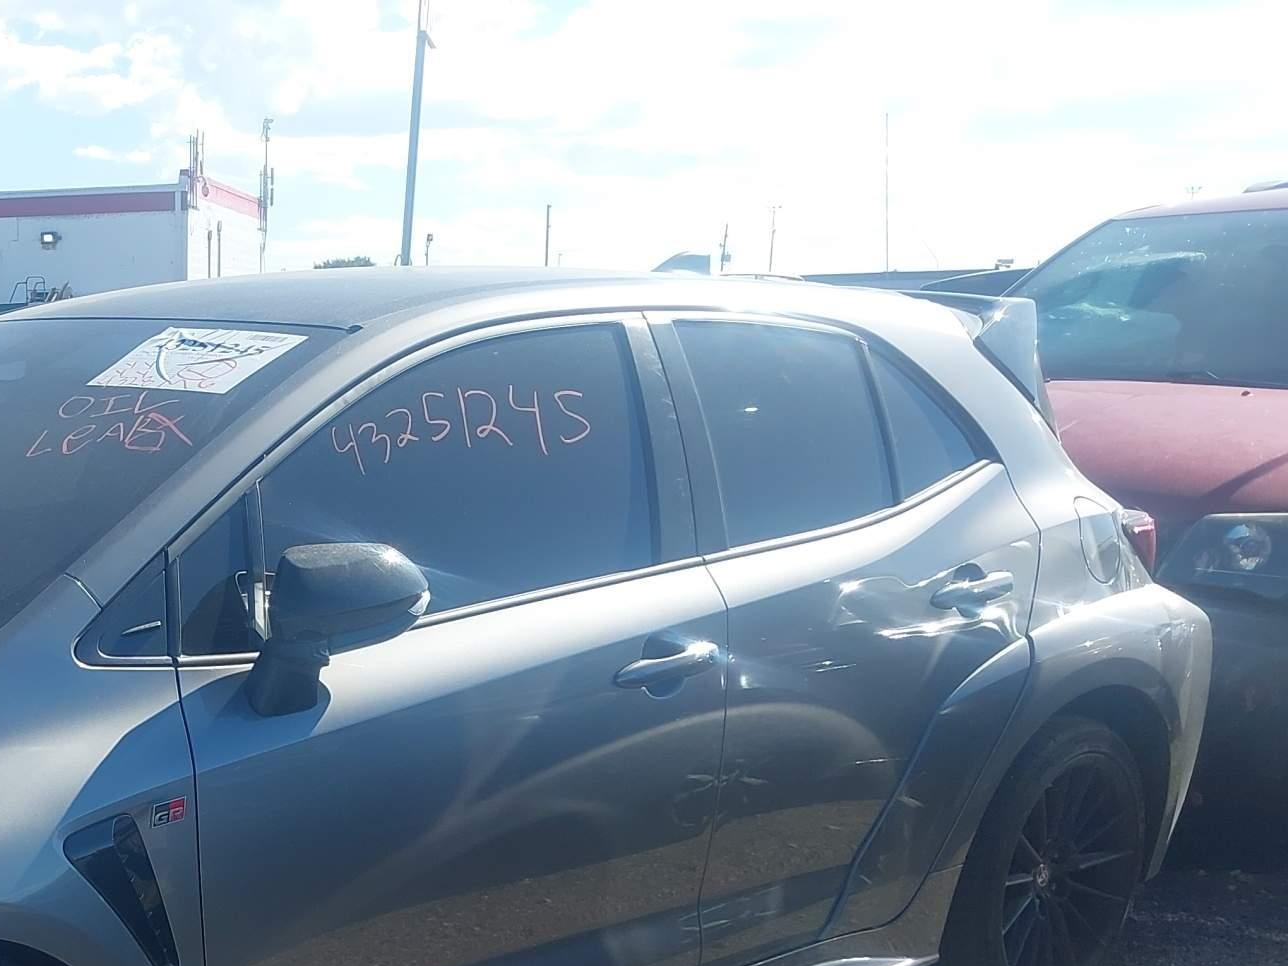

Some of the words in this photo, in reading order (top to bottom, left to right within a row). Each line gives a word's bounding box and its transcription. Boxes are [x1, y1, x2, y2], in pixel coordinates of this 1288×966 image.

[58, 390, 180, 419] OIL
[330, 384, 592, 476] 43251245
[153, 804, 185, 827] GR
